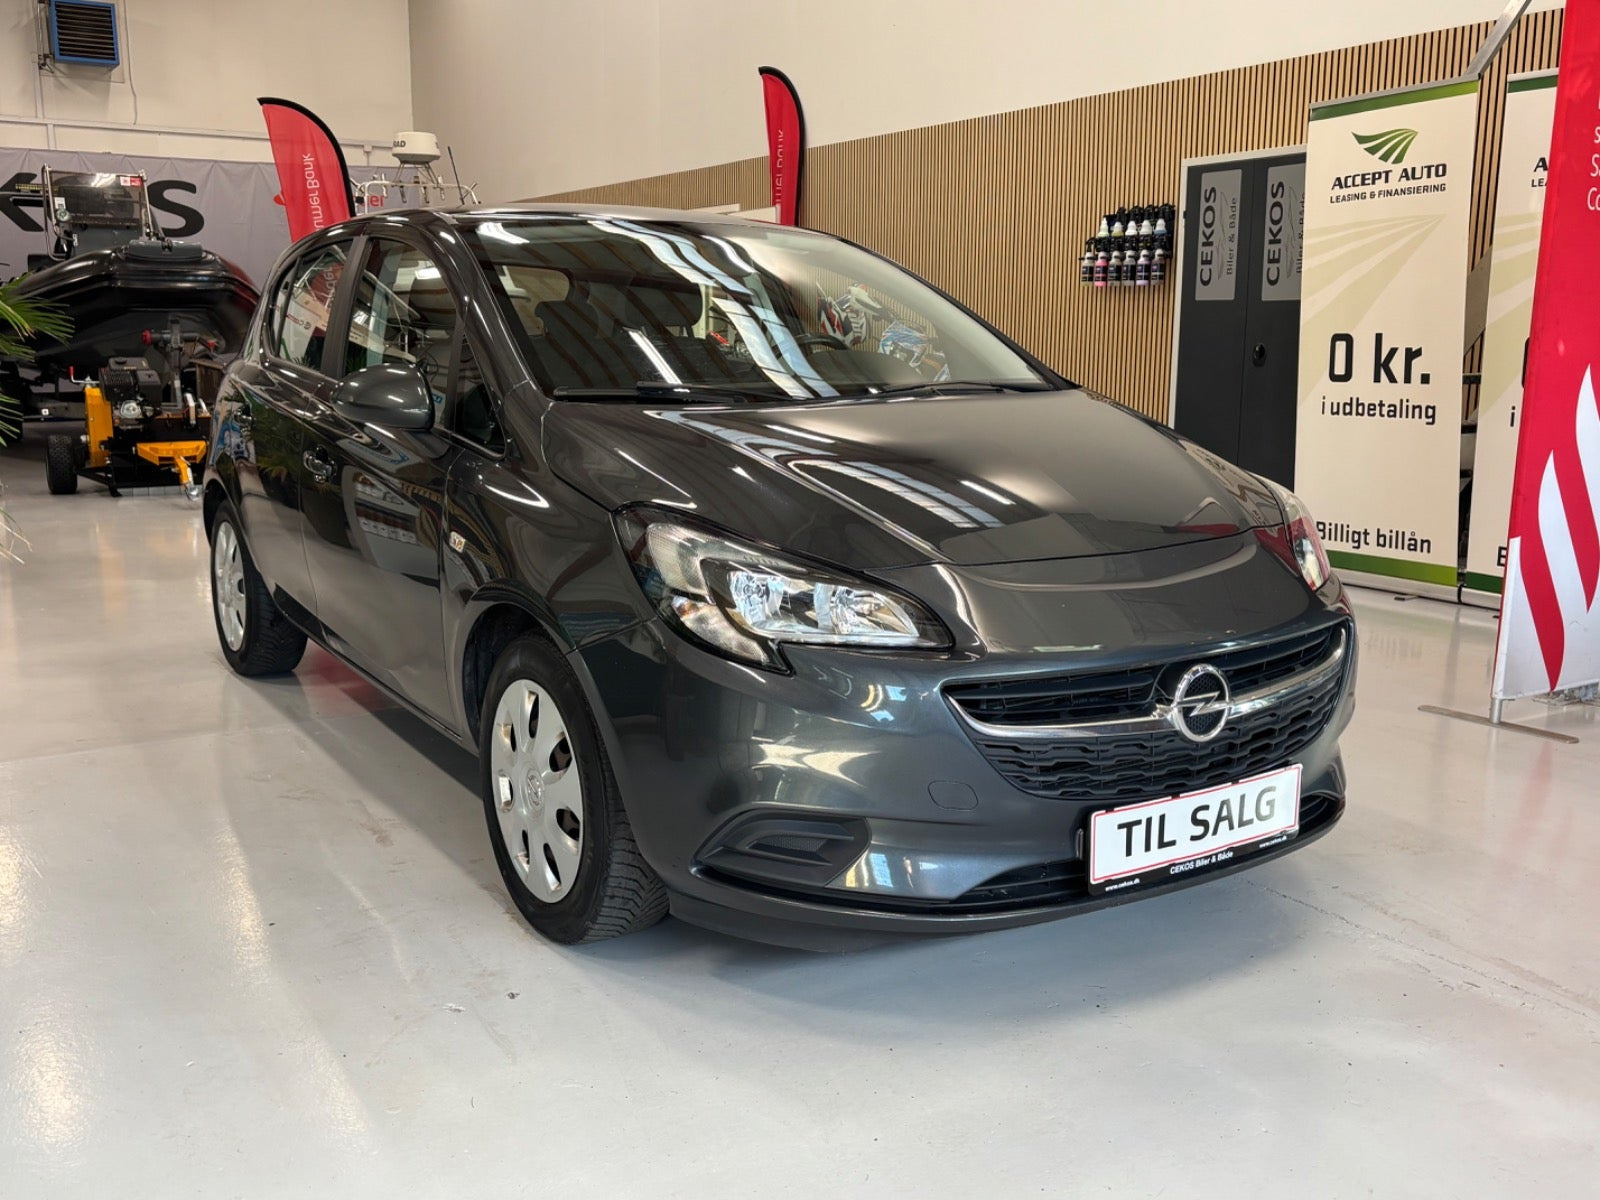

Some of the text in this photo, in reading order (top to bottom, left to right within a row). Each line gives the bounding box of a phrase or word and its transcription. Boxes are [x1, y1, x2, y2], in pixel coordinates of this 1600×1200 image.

[1331, 163, 1447, 190] ACCEPT AUTO
[1330, 183, 1446, 204] LEASING & FINANSIERING
[1228, 198, 1238, 229] Både
[1200, 186, 1217, 286] CEKOS
[1266, 181, 1285, 286] CEKOS
[1226, 247, 1235, 275] Biler
[1329, 333, 1430, 384] 0 kr.
[1321, 396, 1436, 425] i udbetaling
[1510, 406, 1516, 427] i
[1316, 521, 1431, 554] Billigt billån
[1117, 786, 1277, 857] TIL SALG
[1170, 861, 1195, 874] CEKOS
